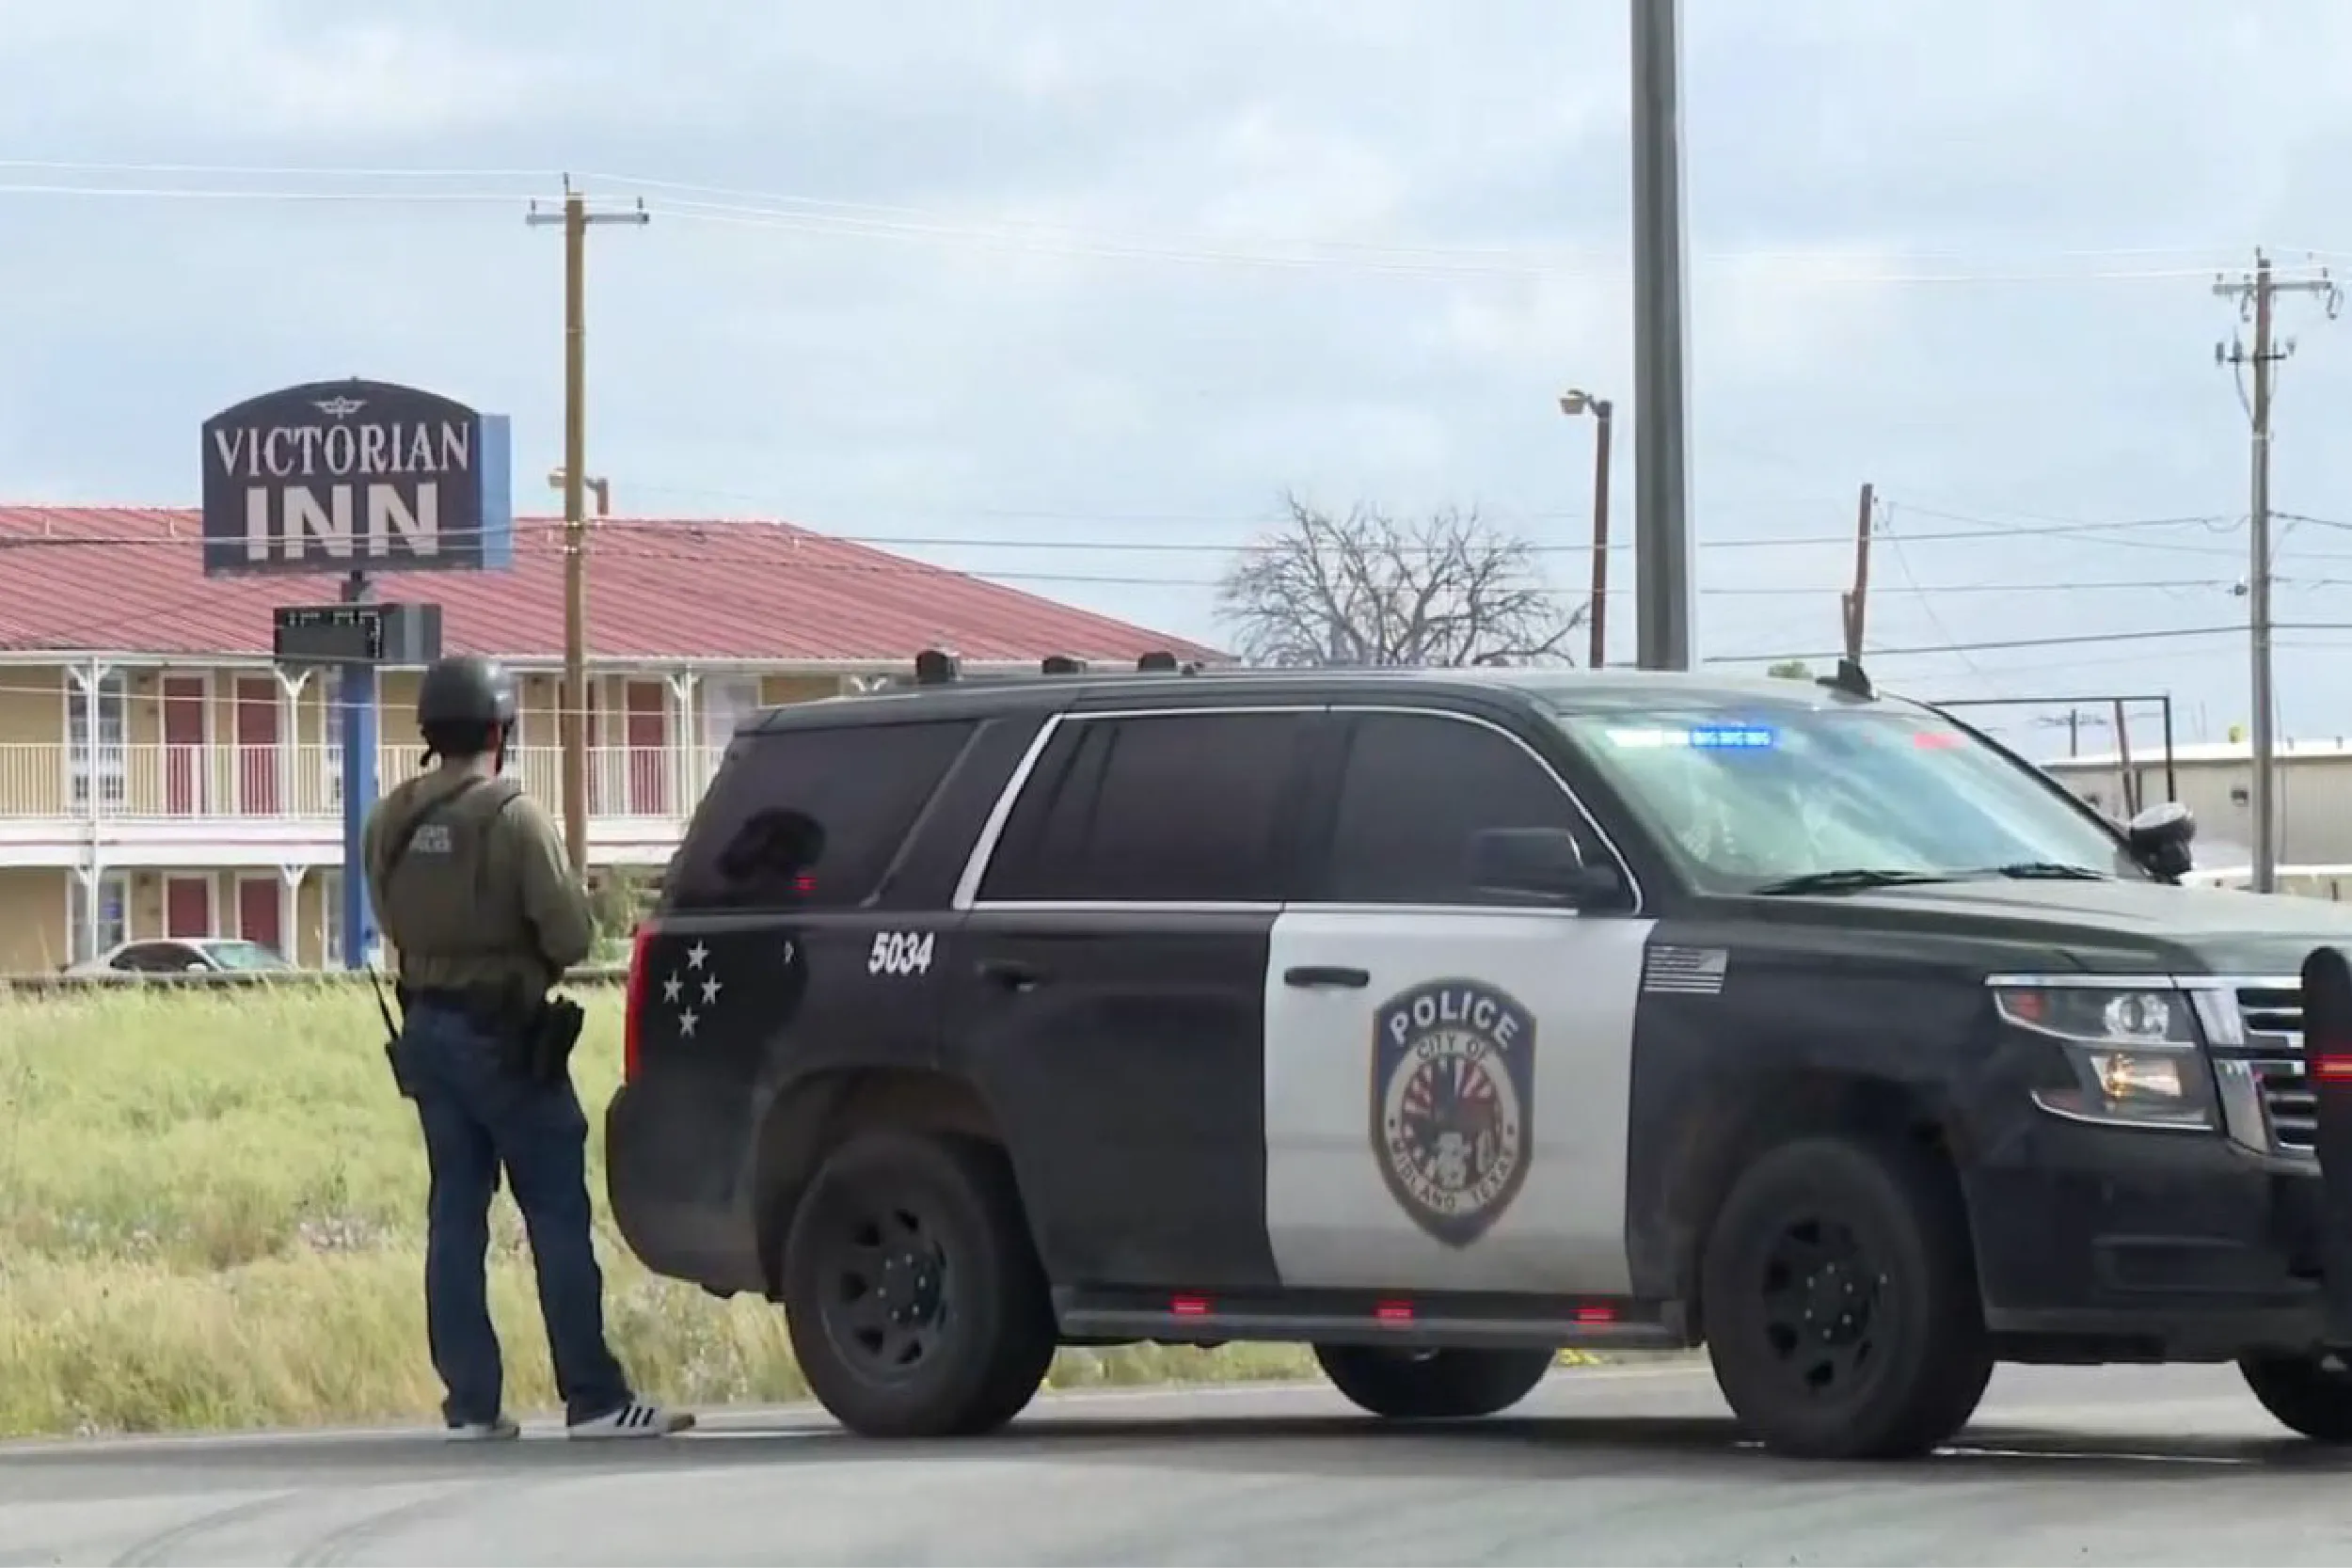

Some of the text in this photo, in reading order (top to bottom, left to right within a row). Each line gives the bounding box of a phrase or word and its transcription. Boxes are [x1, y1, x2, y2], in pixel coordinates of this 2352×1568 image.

[215, 421, 469, 476] VICTORIAN
[246, 482, 438, 561] INN
[868, 931, 934, 975] 5034
[1389, 990, 1518, 1047] POLICE
